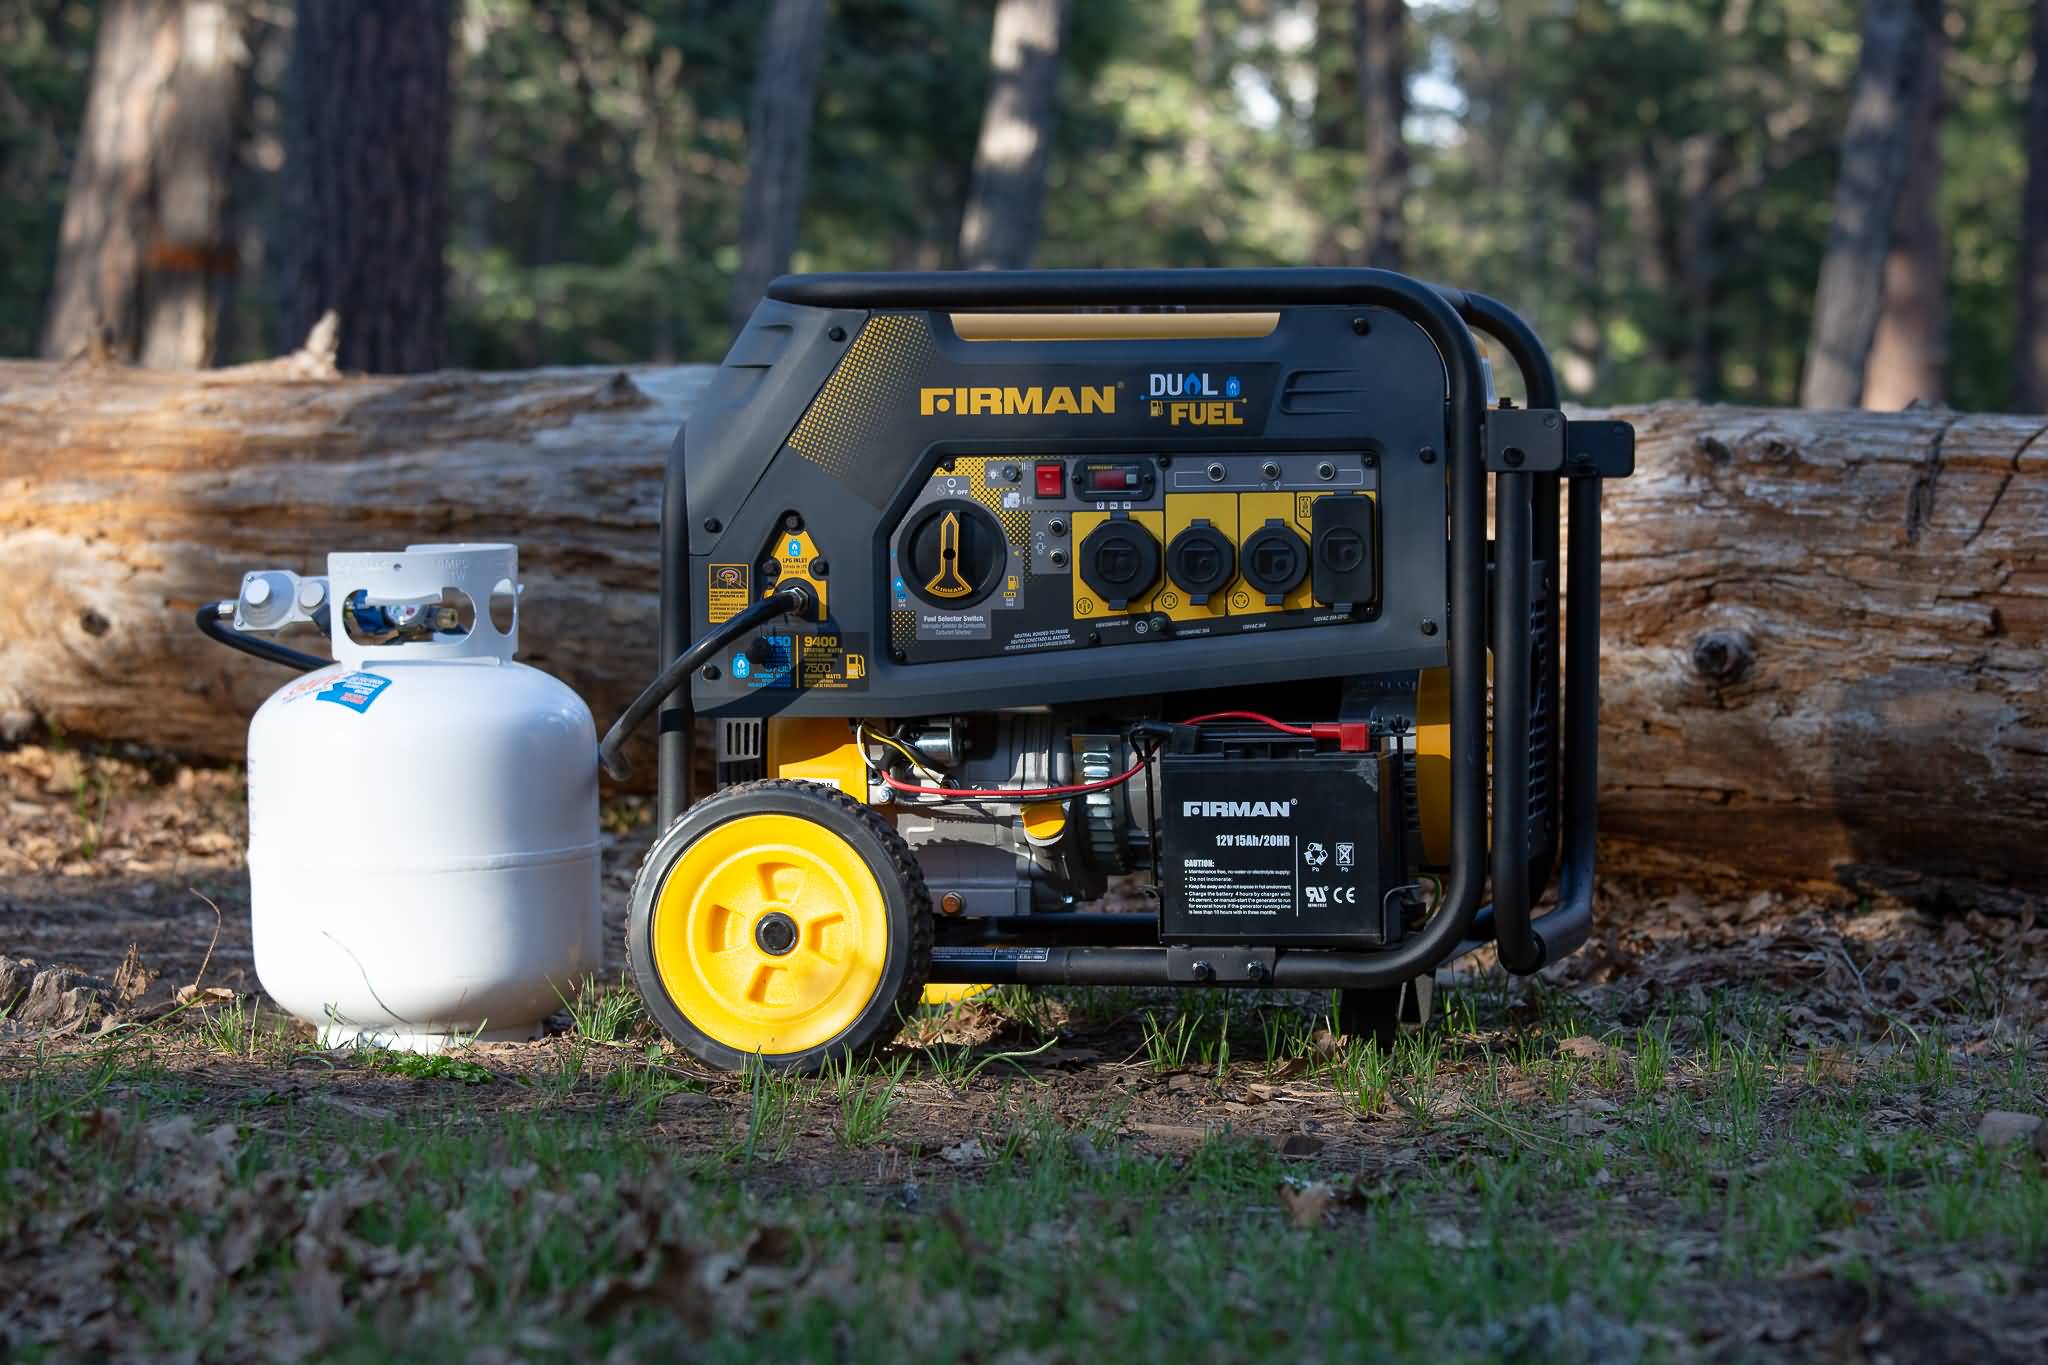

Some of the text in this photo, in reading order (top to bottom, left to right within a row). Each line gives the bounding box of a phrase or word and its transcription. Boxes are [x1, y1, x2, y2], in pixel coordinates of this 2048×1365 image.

[1150, 373, 1219, 397] DUAL
[920, 386, 1116, 416] FIRMAN
[1170, 402, 1244, 426] FUEL
[957, 488, 969, 496] OFF
[923, 615, 984, 623] Fuel Selector Switch
[803, 635, 838, 648] 9400
[805, 662, 831, 673] 7500
[1215, 834, 1290, 847] 12V 15Ah/20HR
[1184, 859, 1215, 868] CAUTION:
[1333, 886, 1357, 904] CE
